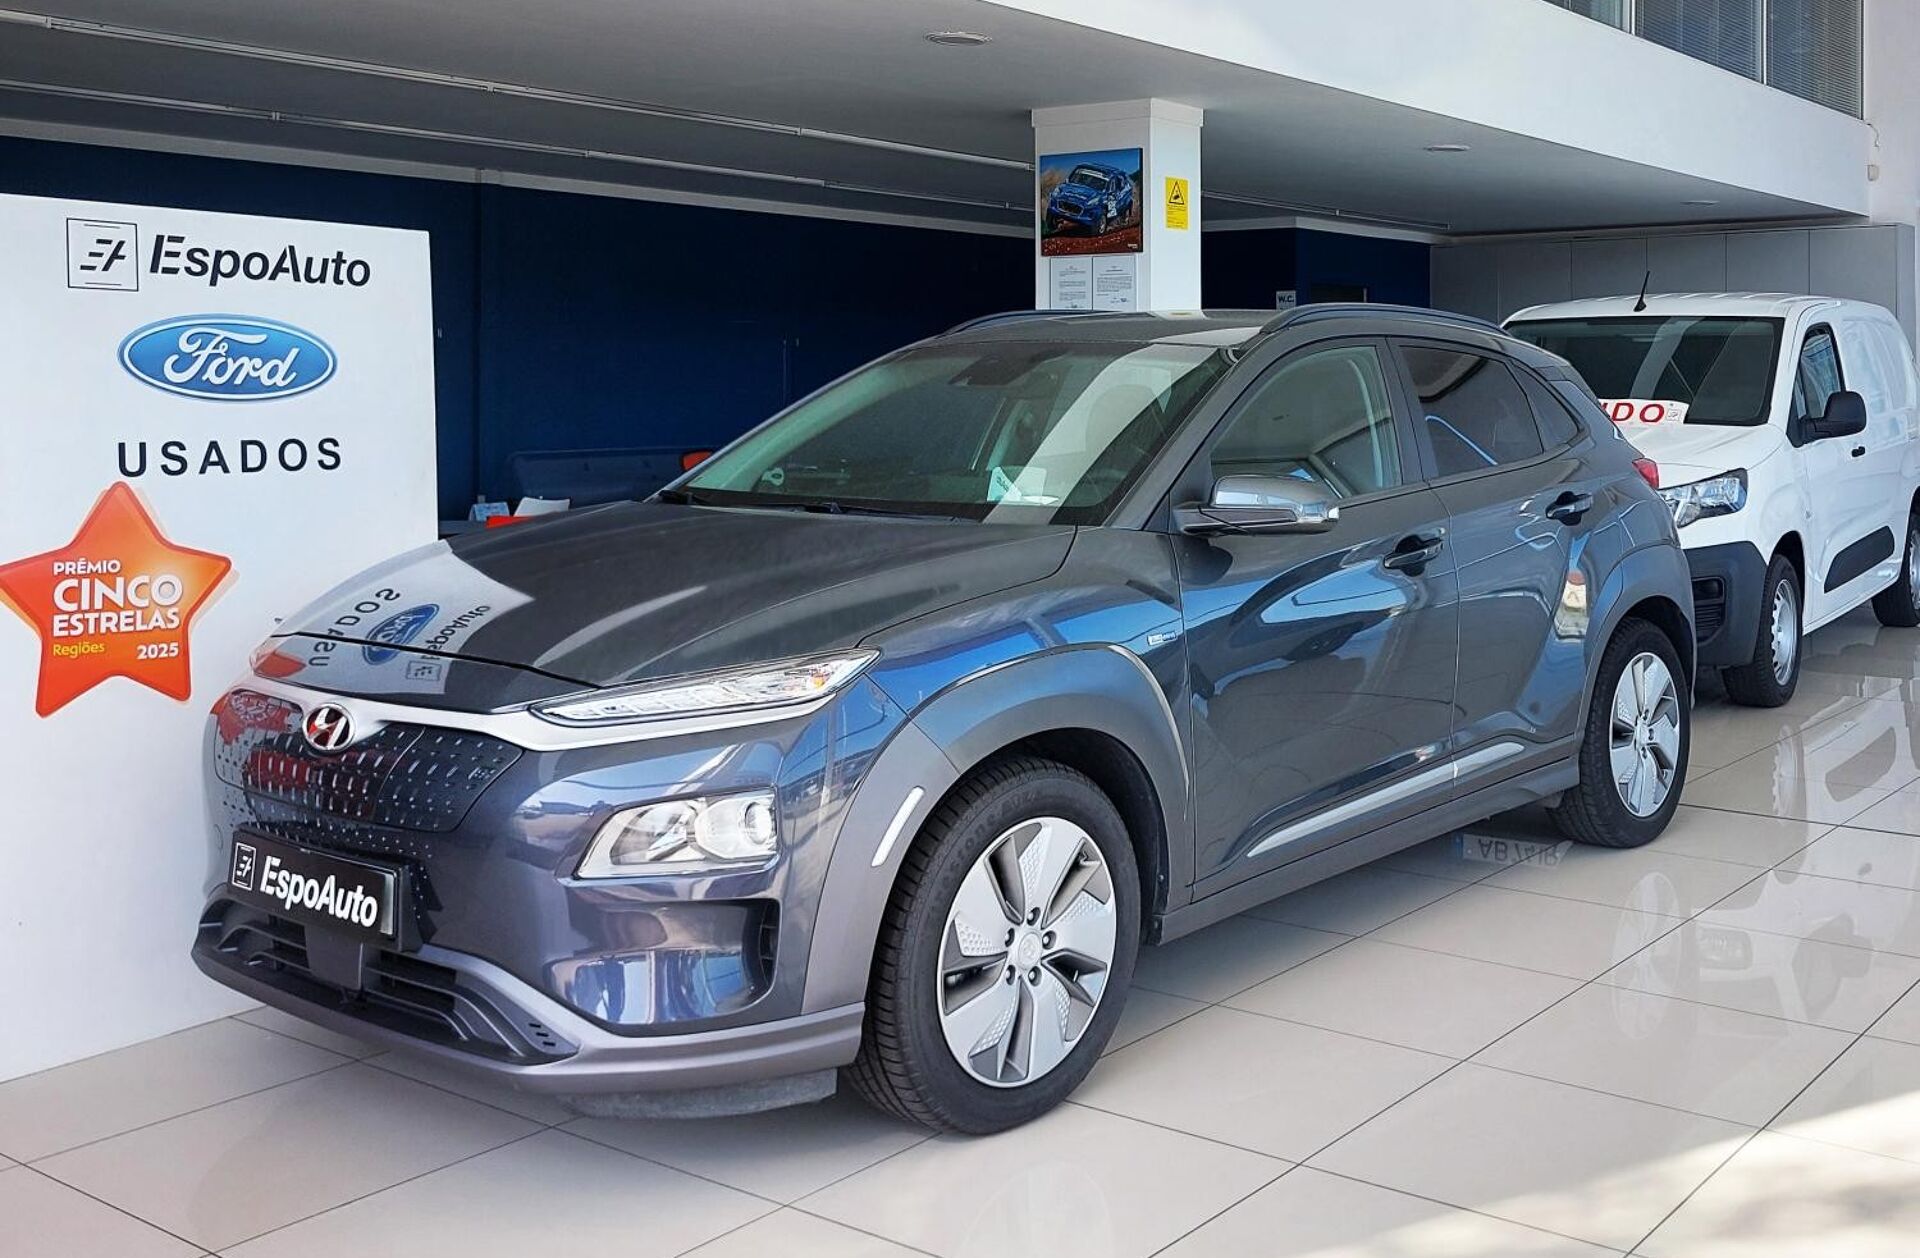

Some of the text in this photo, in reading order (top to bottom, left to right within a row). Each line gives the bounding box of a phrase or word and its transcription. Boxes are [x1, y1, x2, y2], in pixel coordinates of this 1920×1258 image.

[150, 234, 371, 287] EspoAuto
[163, 326, 300, 387] Ford
[1601, 402, 1665, 423] DO
[118, 437, 342, 477] USADOS
[53, 558, 121, 575] PRÉMIO
[53, 573, 183, 613] CINCO
[53, 607, 180, 638] ESTRELAS
[53, 641, 105, 659] Regiões
[136, 641, 179, 660] 2025
[259, 855, 378, 928] EspoAuto
